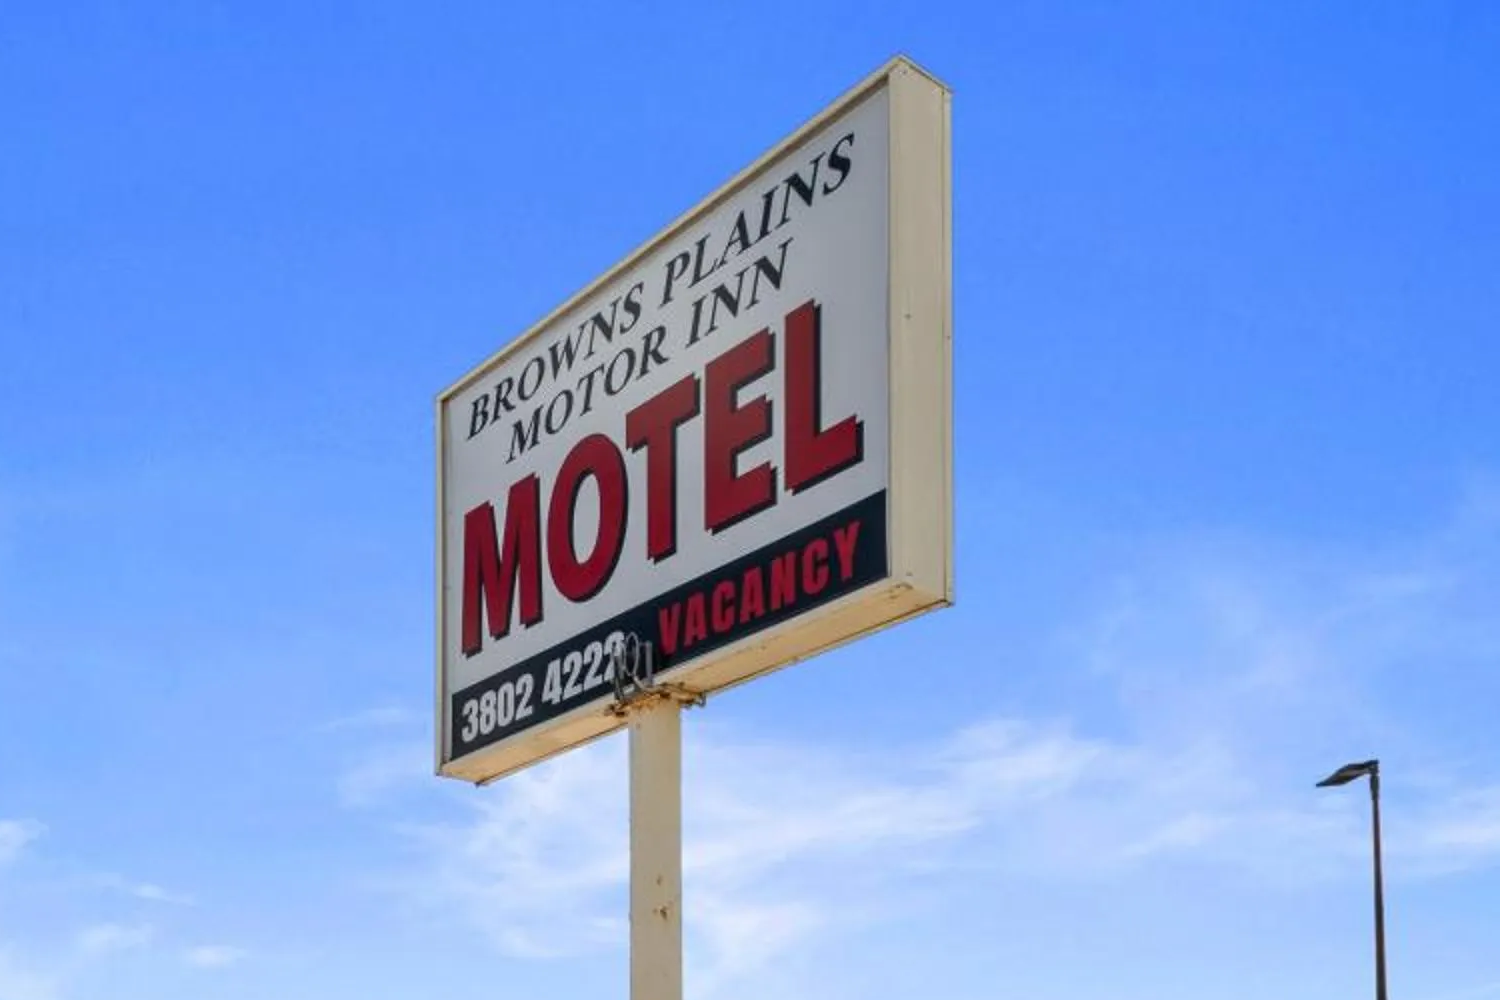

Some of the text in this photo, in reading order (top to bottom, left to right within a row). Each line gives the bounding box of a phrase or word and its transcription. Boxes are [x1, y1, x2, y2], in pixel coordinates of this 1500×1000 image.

[466, 131, 855, 440] BROWNS PLAINS
[505, 237, 795, 465] MOTOR INN
[461, 298, 865, 658] MOTEL
[658, 520, 861, 656] VACANCY
[461, 673, 534, 743] 3802
